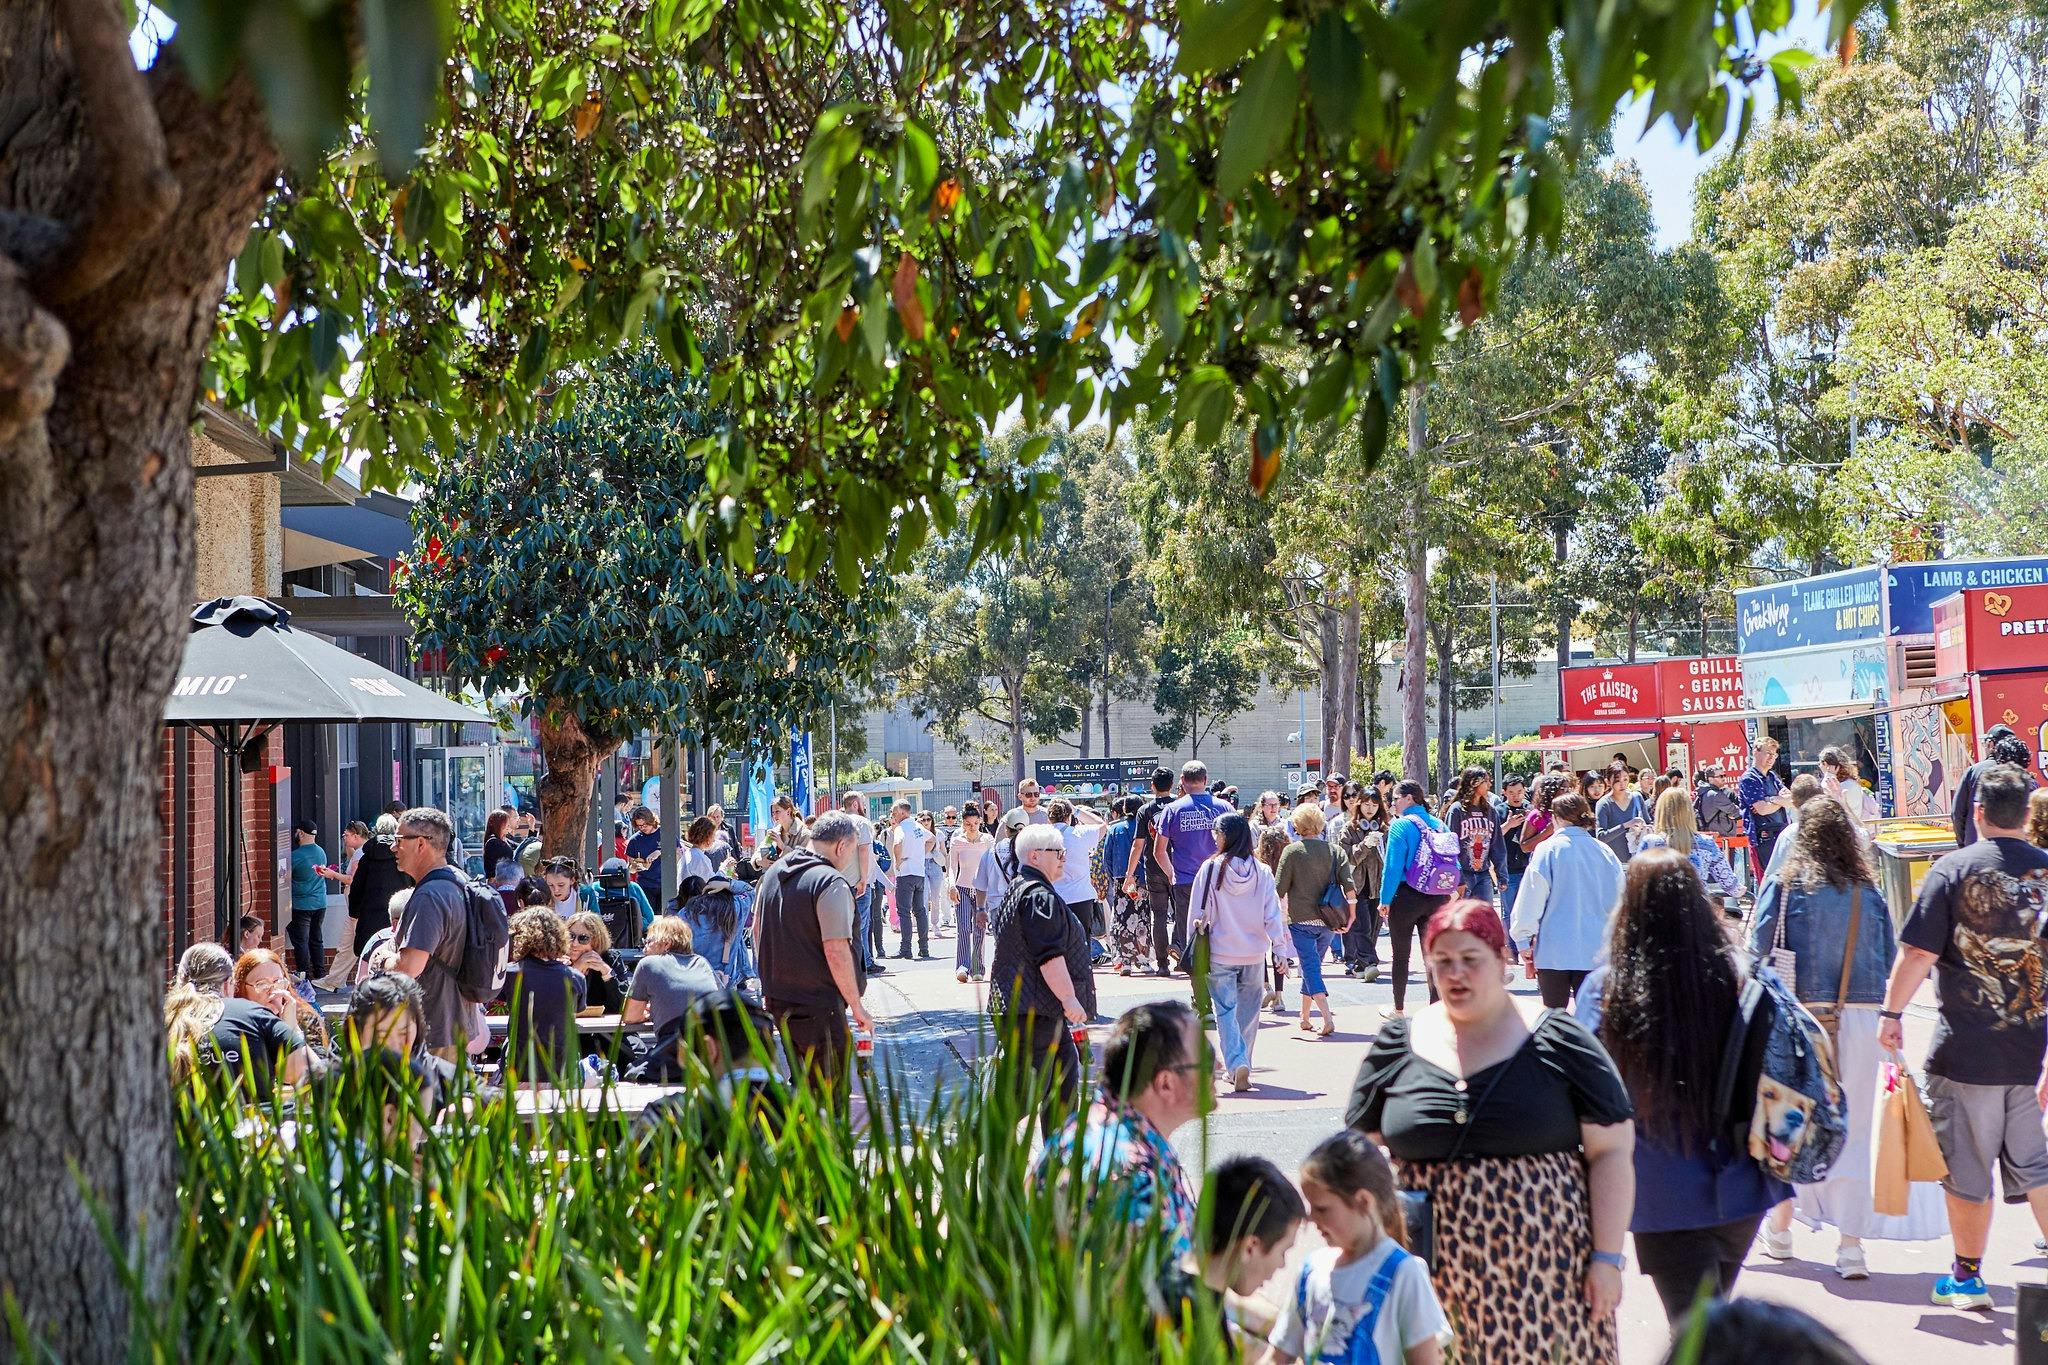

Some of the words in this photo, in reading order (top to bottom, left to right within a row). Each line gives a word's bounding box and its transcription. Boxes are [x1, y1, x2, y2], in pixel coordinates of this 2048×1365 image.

[1924, 571, 1963, 587] LAMB
[1967, 570, 1978, 586] &
[1981, 567, 2043, 585] CHICKEN
[1803, 590, 1825, 612] FLAME
[1825, 585, 1854, 610] GRILLED
[1854, 580, 1879, 605] WRAPS
[1835, 609, 1842, 631] &
[1843, 607, 1858, 630] HOT
[1858, 604, 1880, 628] CHIPS
[2001, 619, 2048, 636] PRET
[1580, 684, 1598, 705] THE
[1599, 681, 1639, 704] KAISER'S
